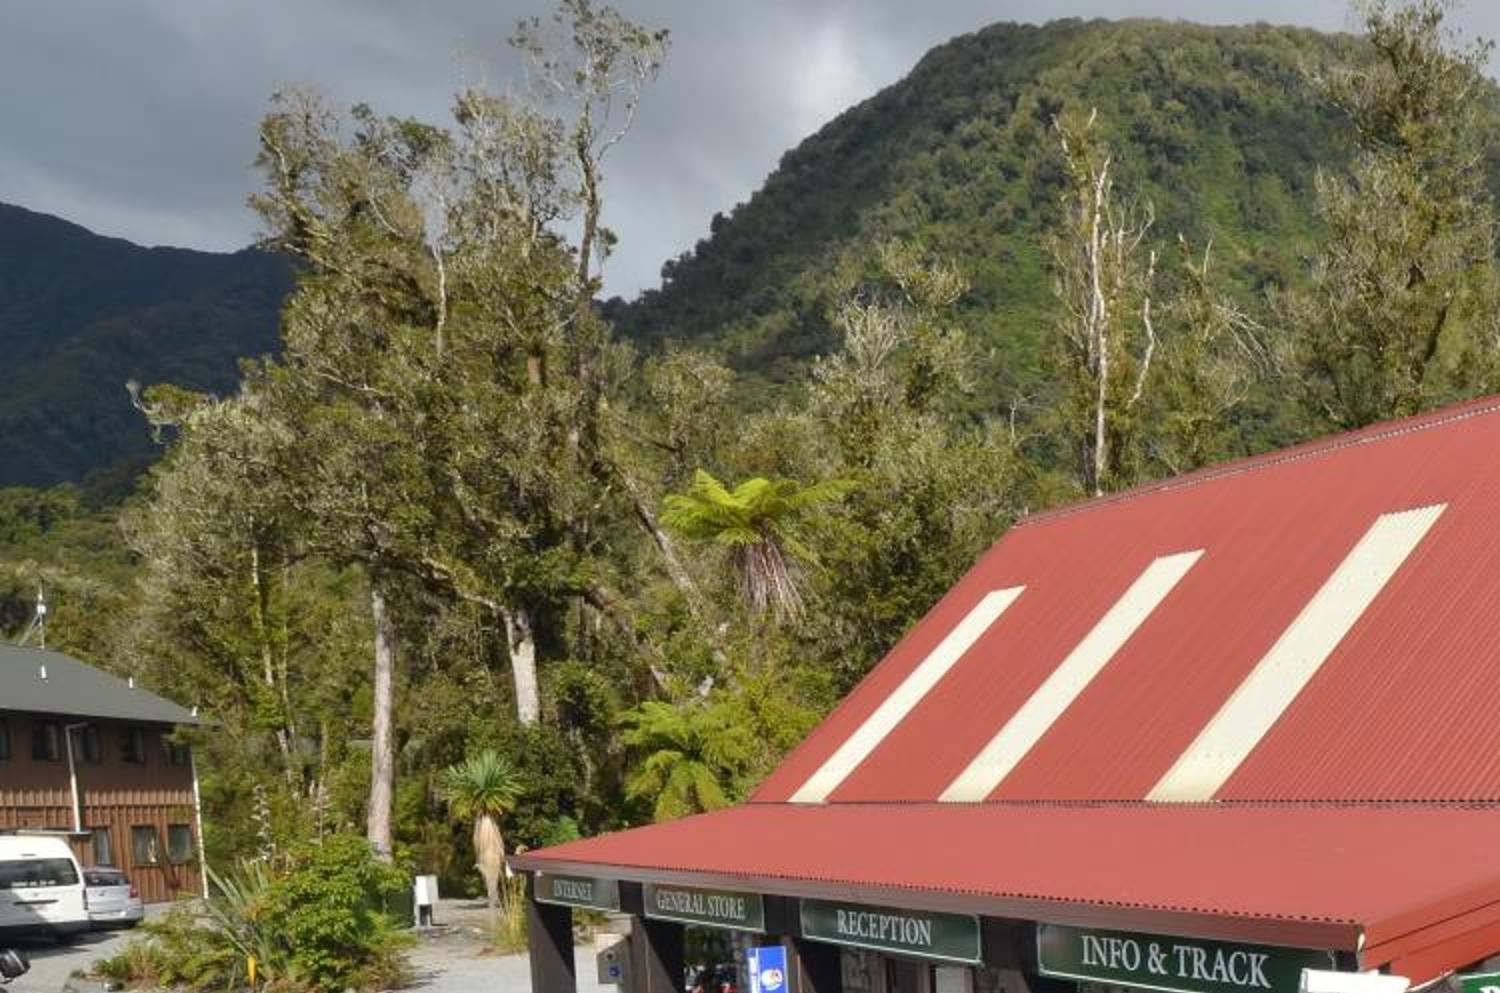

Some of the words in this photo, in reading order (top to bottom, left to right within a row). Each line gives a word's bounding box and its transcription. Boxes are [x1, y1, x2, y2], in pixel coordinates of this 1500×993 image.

[656, 889, 706, 916] GENERAL
[707, 895, 746, 920] STORE
[836, 909, 932, 946] RECEPTION
[1081, 935, 1140, 971] INFO
[1147, 943, 1168, 975] &
[1172, 944, 1272, 989] TRACK
